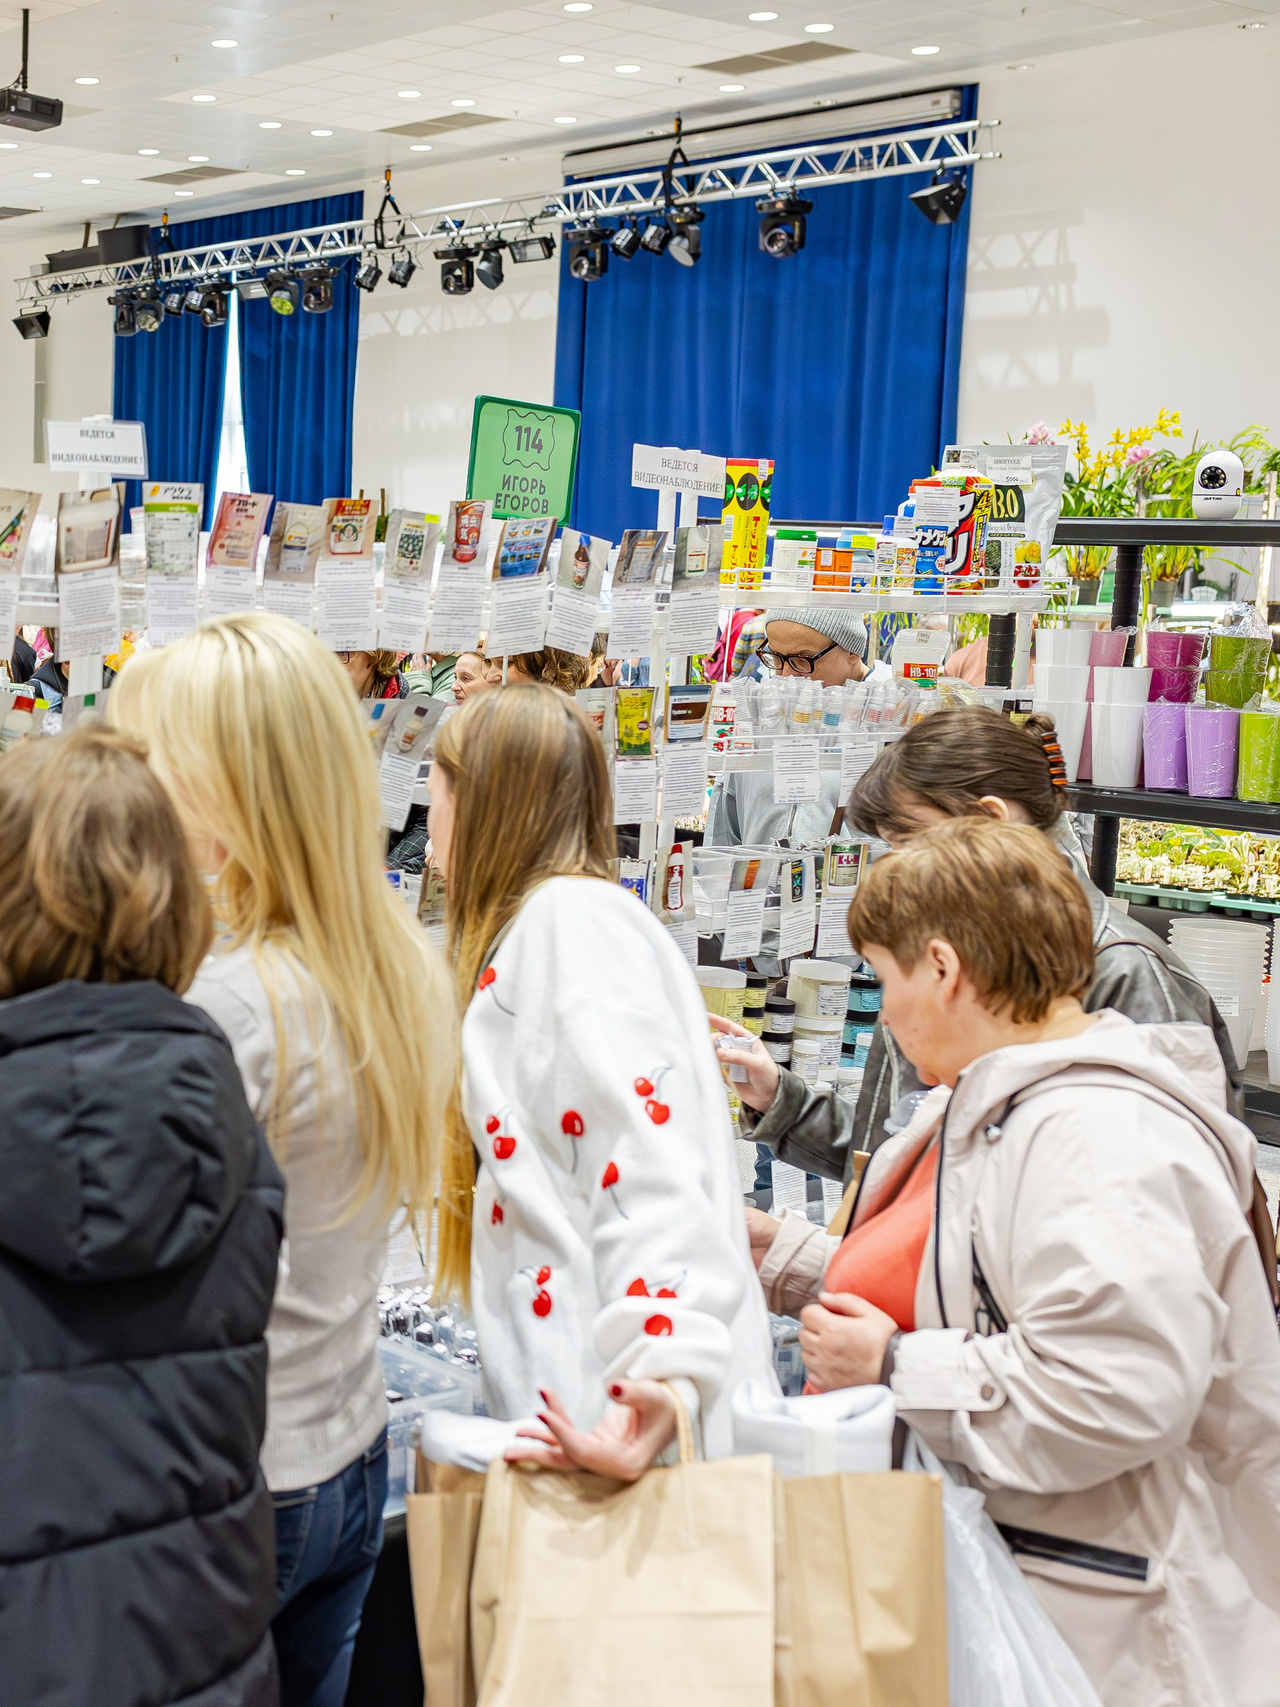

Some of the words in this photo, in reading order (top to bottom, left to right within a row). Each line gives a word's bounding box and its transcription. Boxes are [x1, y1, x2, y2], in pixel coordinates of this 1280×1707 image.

[514, 425, 544, 454] 114
[661, 457, 699, 473] ВЕДЕТСЯ
[501, 474, 547, 496] ИГОРЬ
[633, 470, 724, 494] ВИДЕОНАБЛЮДЕНИЕ!
[494, 493, 549, 515] ЕГОРОВ
[992, 488, 1019, 519] B.O
[909, 667, 937, 678] HB-101
[713, 706, 736, 722] HB-101
